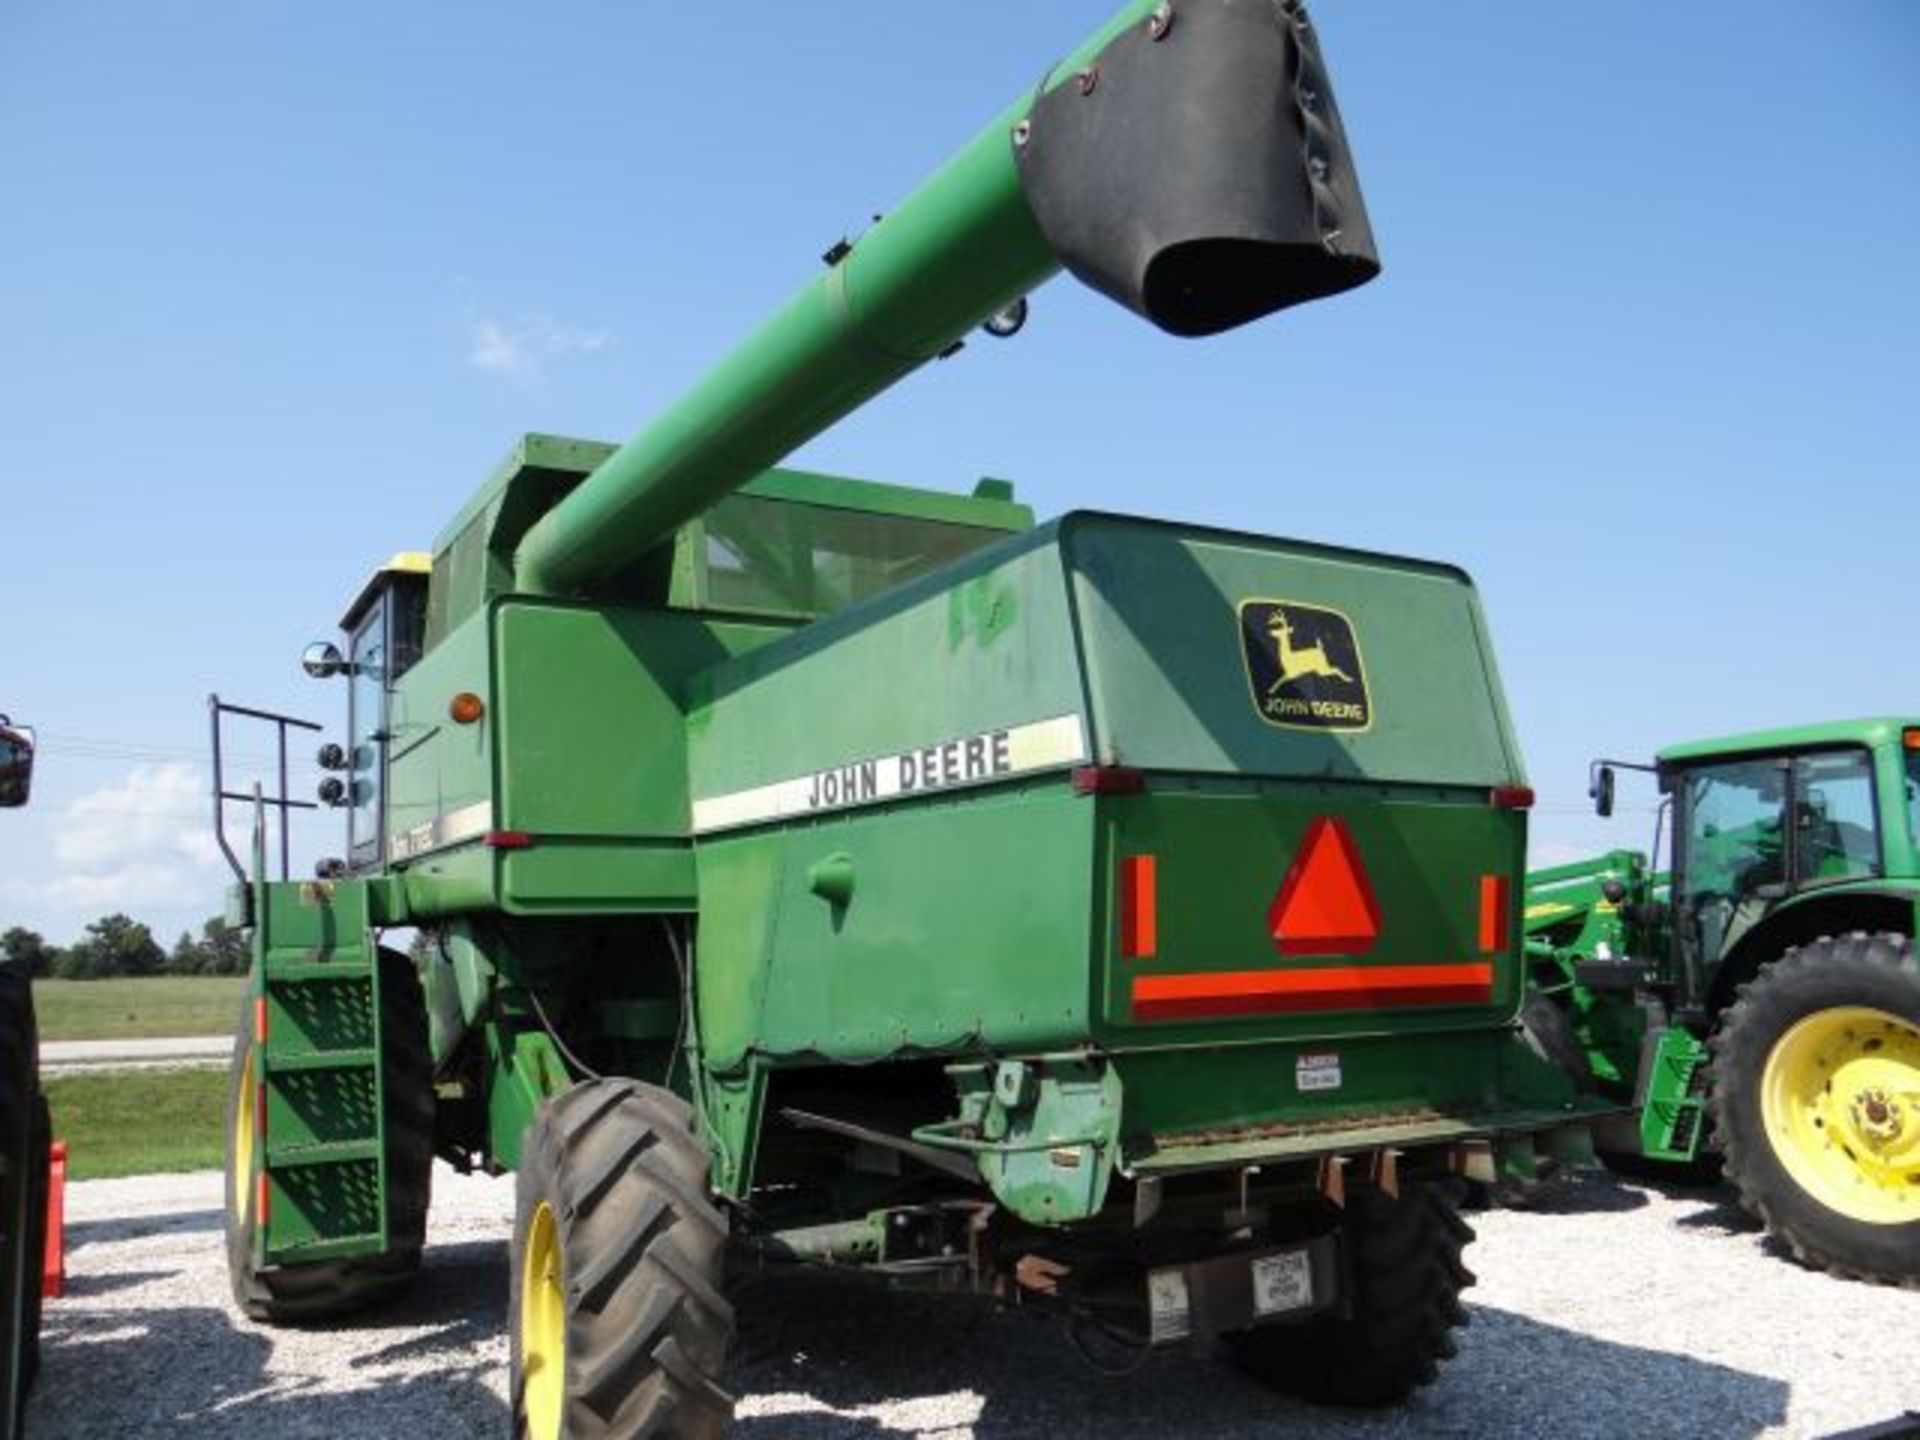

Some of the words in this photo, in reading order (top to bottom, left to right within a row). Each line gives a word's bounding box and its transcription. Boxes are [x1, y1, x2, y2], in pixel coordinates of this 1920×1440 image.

[1265, 698, 1309, 715] JOHN
[1310, 701, 1365, 720] DEERE
[809, 761, 877, 808] JOHN
[900, 731, 1009, 789] DEERE
